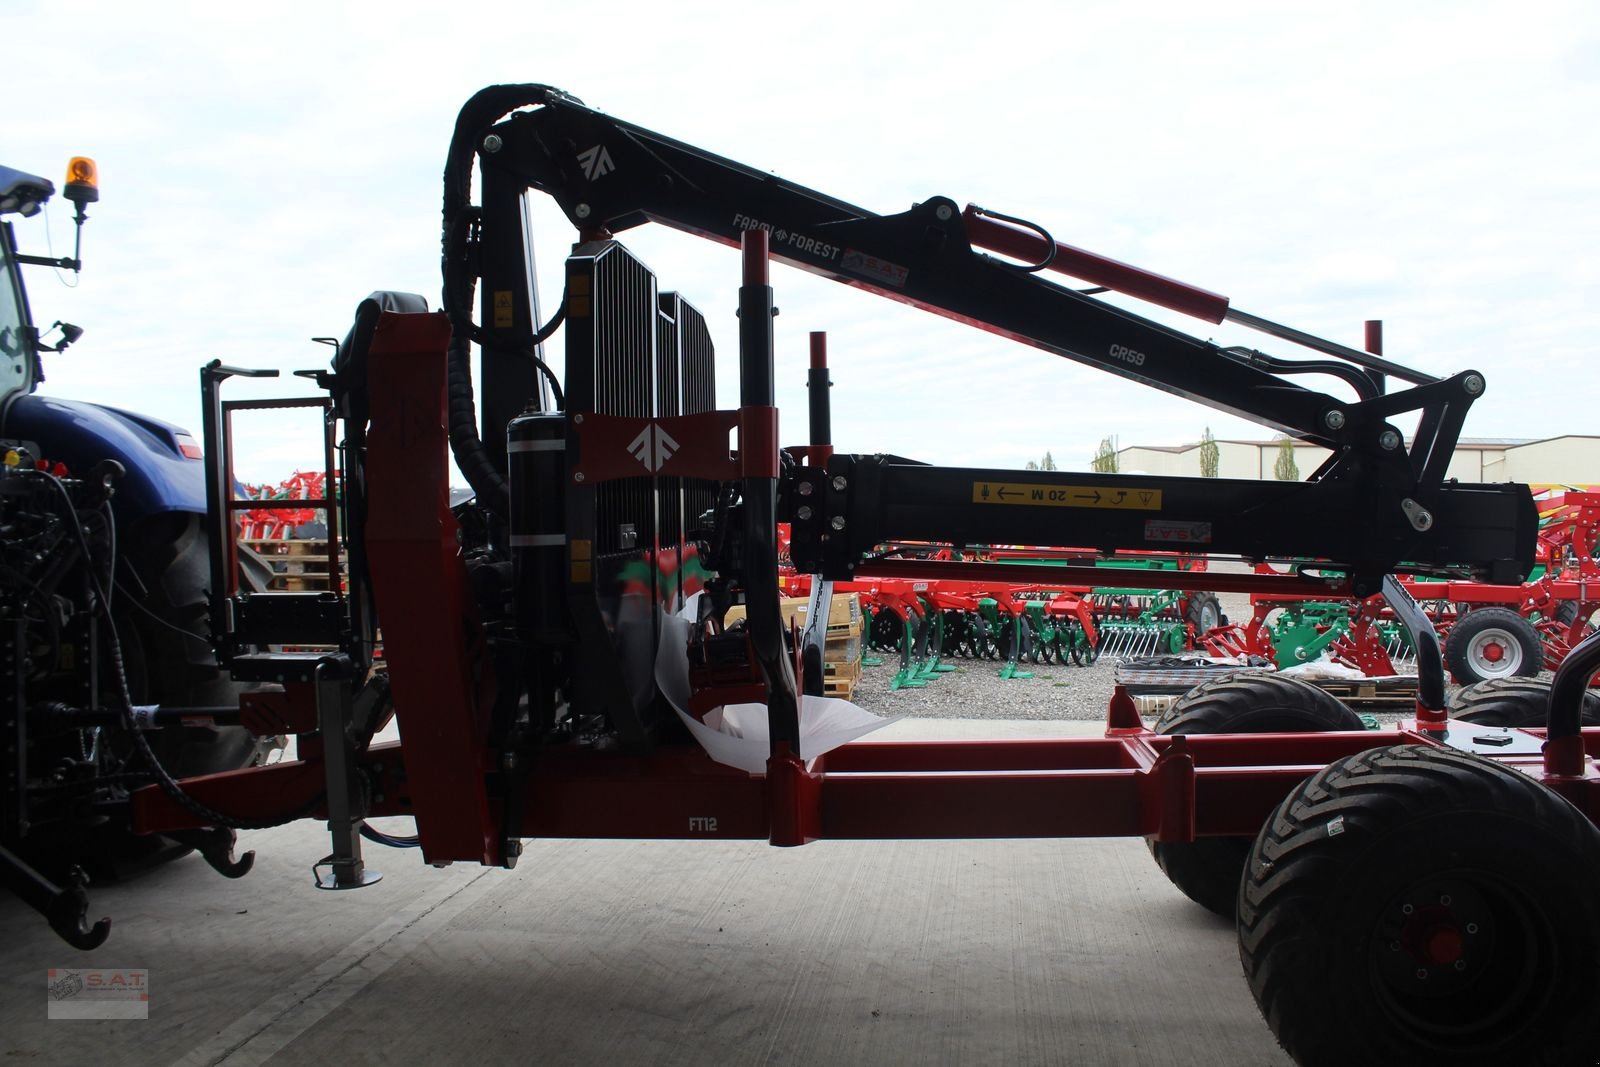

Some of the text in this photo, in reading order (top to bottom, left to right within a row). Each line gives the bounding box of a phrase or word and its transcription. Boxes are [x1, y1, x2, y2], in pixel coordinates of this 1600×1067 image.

[788, 232, 841, 260] FOREST
[1109, 344, 1145, 366] CR59
[1031, 489, 1067, 502] 20 M
[688, 816, 718, 832] FT12
